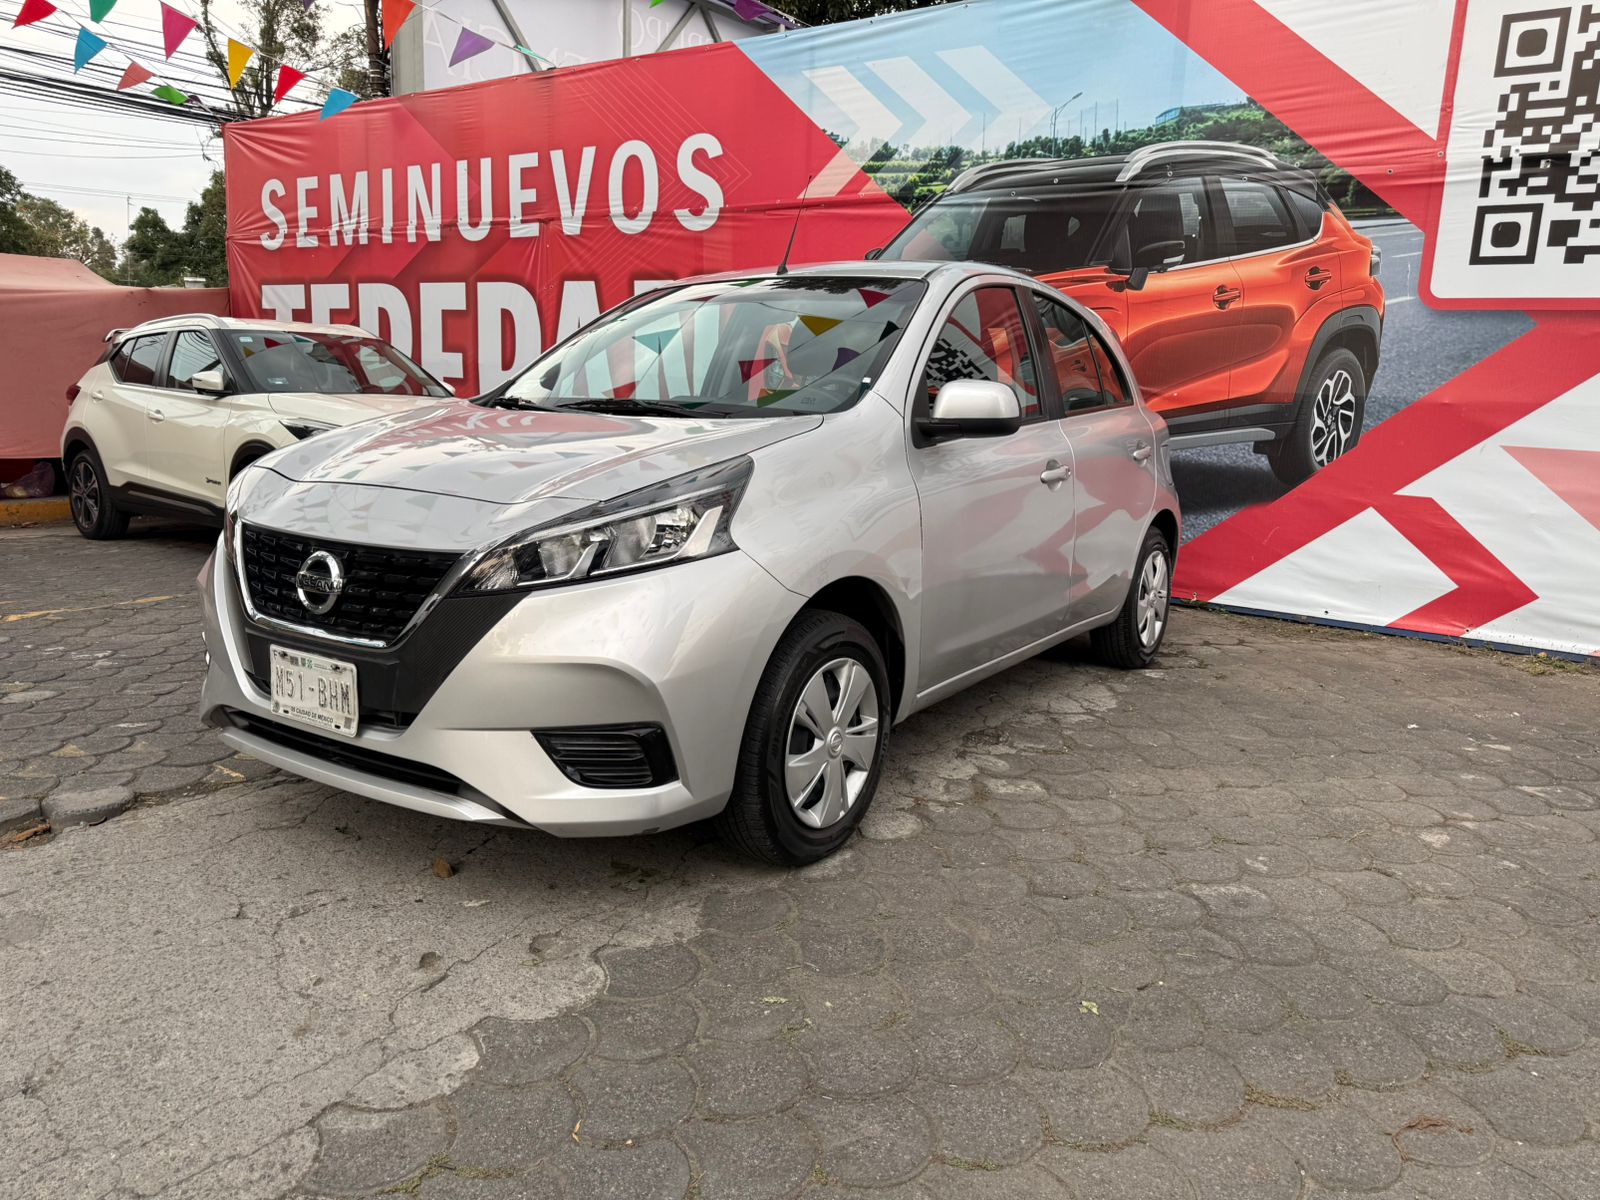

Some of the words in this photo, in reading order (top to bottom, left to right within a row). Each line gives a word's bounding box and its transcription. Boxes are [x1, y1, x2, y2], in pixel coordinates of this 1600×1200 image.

[259, 133, 725, 251] SEMINUEVOS
[261, 279, 722, 400] PEPAN
[275, 664, 352, 715] M51-BHM
